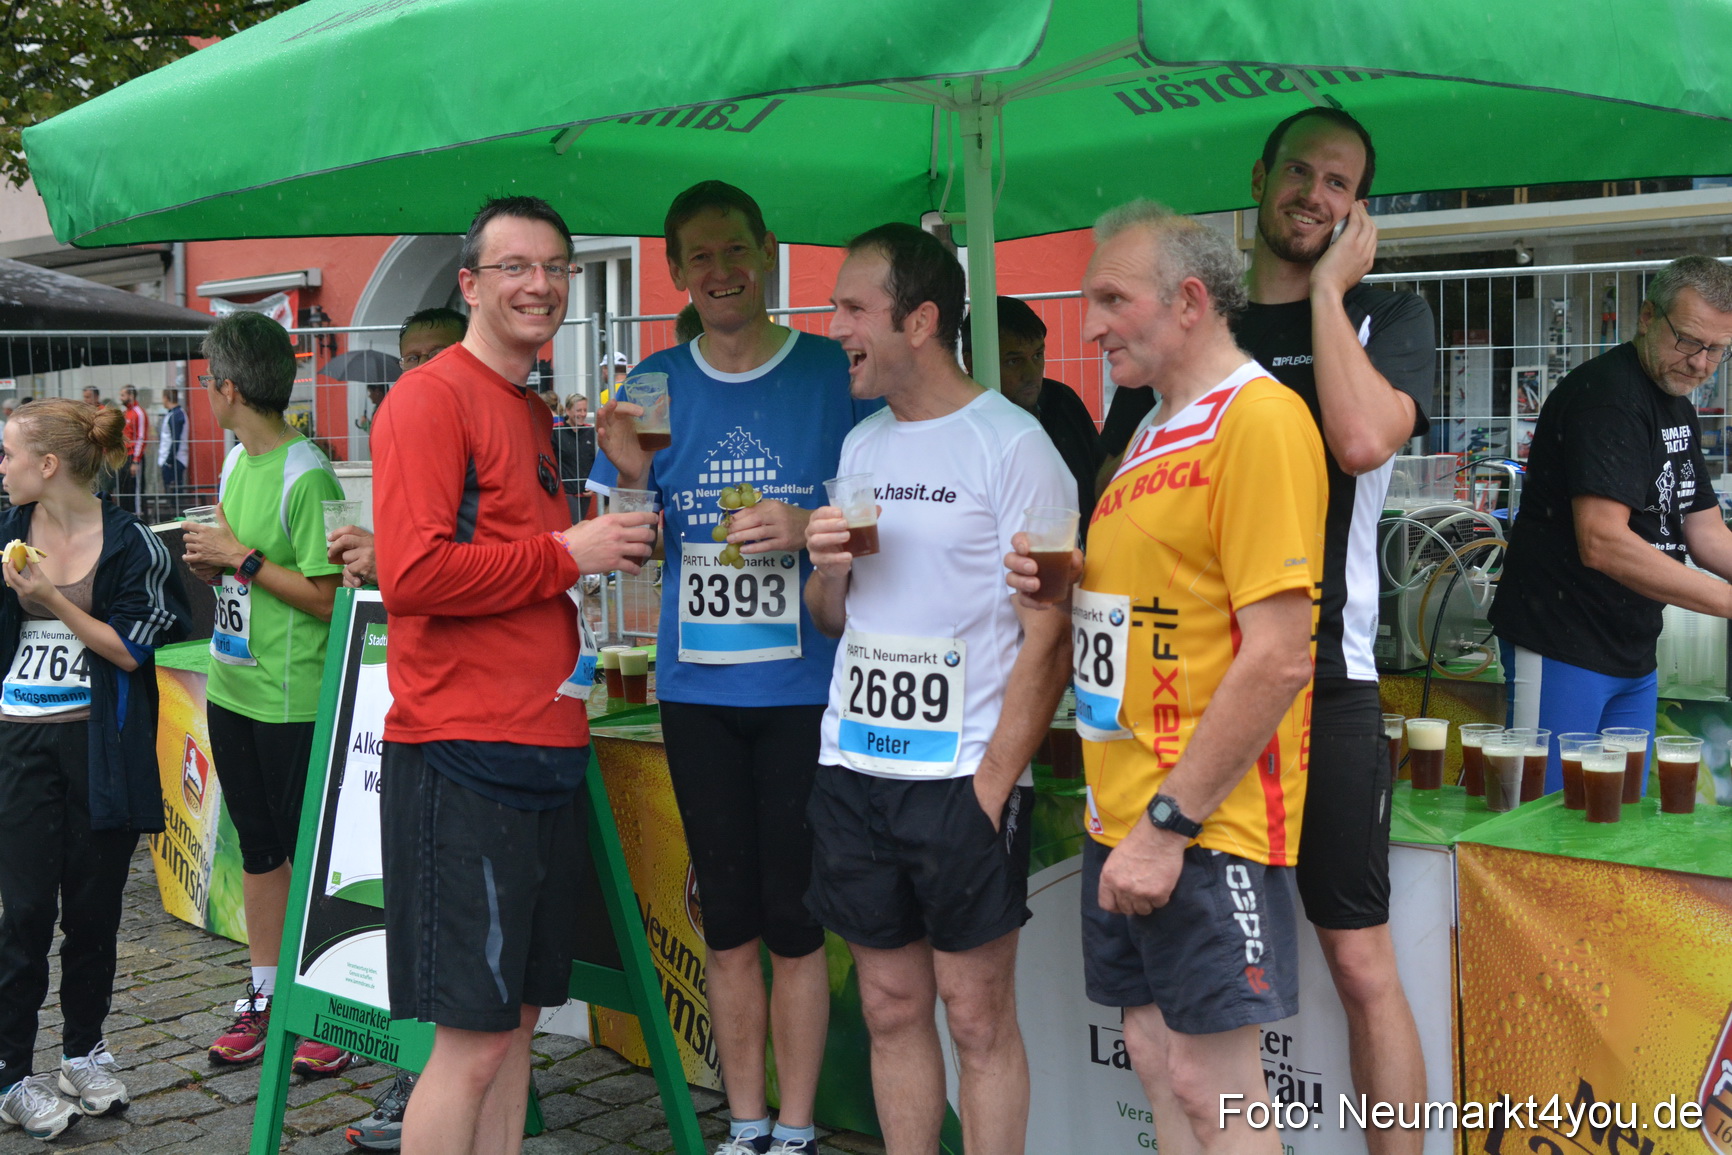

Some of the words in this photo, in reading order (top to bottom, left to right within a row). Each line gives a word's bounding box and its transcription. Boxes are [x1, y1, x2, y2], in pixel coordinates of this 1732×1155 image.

[763, 484, 814, 495] Stadtlauf
[1129, 459, 1210, 502] BÖGL
[683, 555, 710, 566] PARTL
[688, 573, 786, 618] 3393
[16, 644, 91, 683] 2764
[847, 644, 870, 660] PARTL
[873, 648, 938, 664] Neumarkt
[13, 688, 87, 704] Grossmann
[849, 665, 949, 723] 2689
[867, 732, 910, 755] Peter
[328, 997, 392, 1031] Neumarkter
[313, 1014, 399, 1063] Lammsbräu
[1117, 1100, 1153, 1123] Vera
